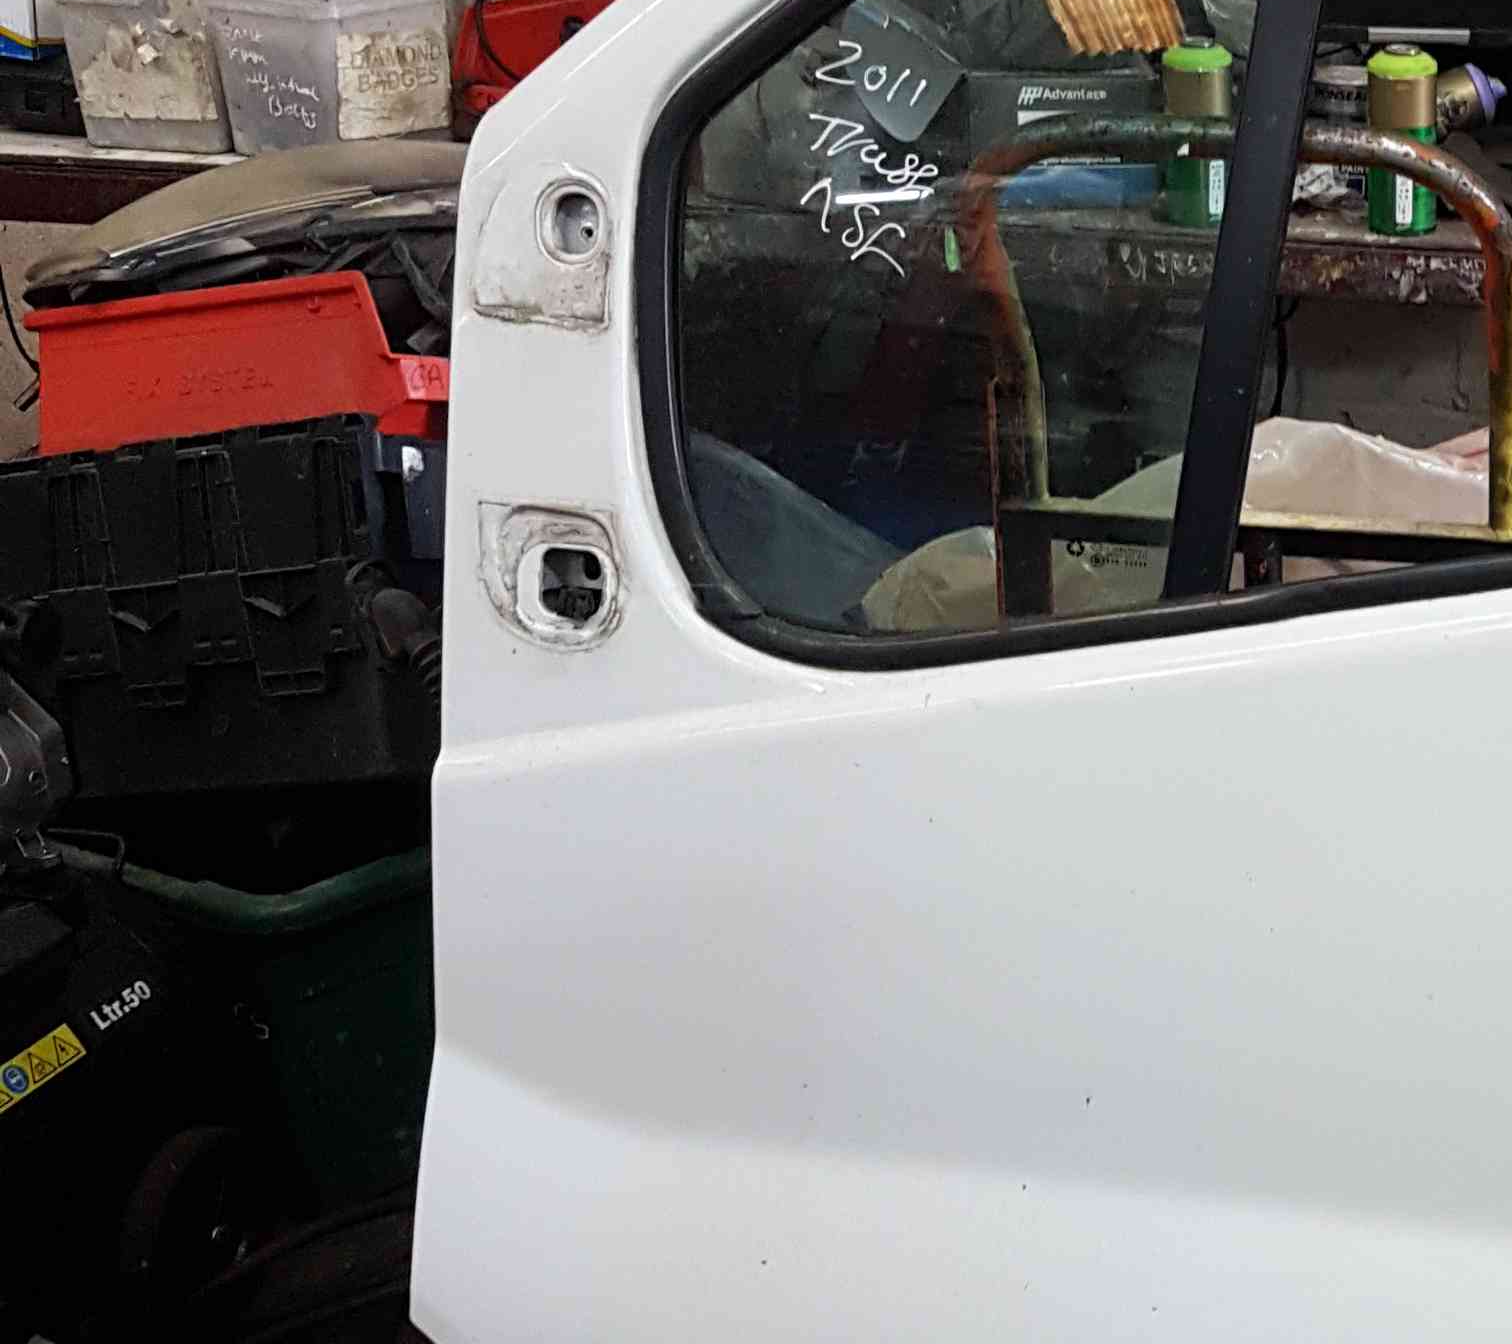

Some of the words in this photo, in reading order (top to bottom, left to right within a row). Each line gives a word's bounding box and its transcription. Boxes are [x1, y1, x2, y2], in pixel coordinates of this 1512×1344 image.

[357, 65, 440, 94] BADGES
[815, 40, 926, 106] 2011
[89, 980, 152, 1031] Ltr.50
